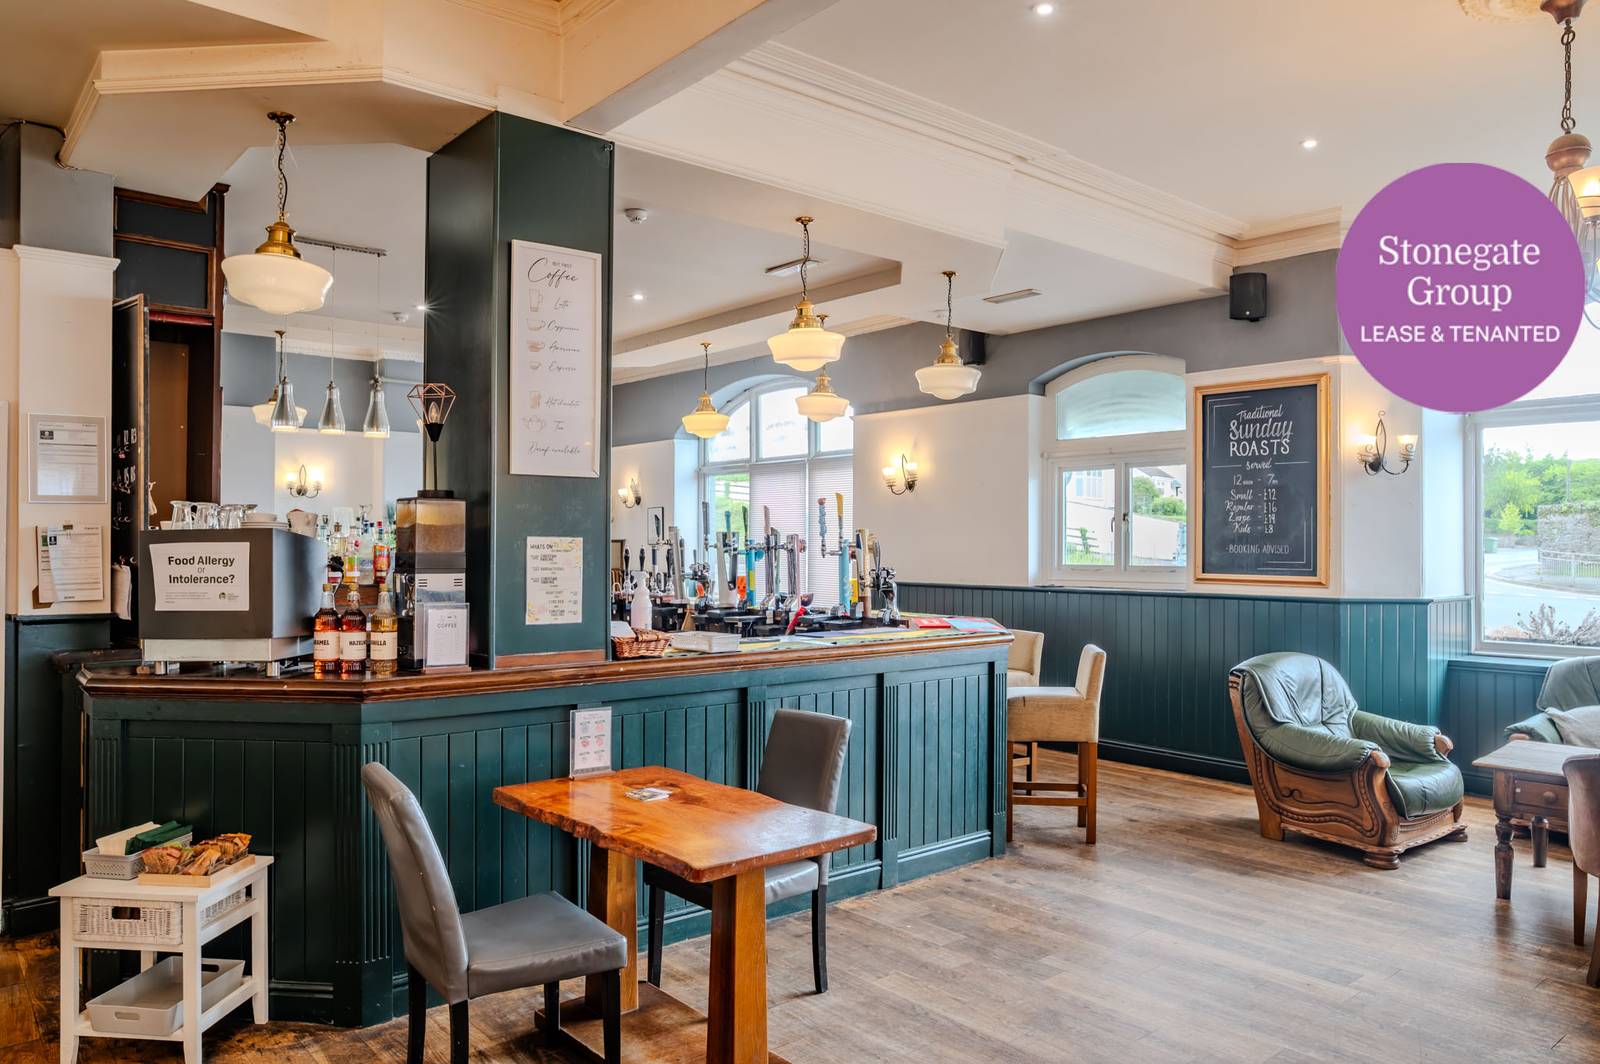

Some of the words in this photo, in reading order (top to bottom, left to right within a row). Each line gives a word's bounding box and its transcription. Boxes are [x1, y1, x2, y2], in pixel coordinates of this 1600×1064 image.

[527, 256, 579, 289] Coffee
[1236, 404, 1283, 422] Traditional
[1229, 417, 1294, 441] Sunday
[1229, 438, 1290, 457] ROASTS
[1245, 457, 1272, 471] served
[1229, 488, 1253, 501] Small
[1232, 522, 1252, 535] Kids
[1228, 543, 1260, 554] BOOKING
[1262, 544, 1290, 554] ADVISED
[167, 555, 196, 566] Food
[196, 555, 236, 568] Allergy
[197, 566, 206, 574] or
[168, 574, 236, 585] Intolerance?
